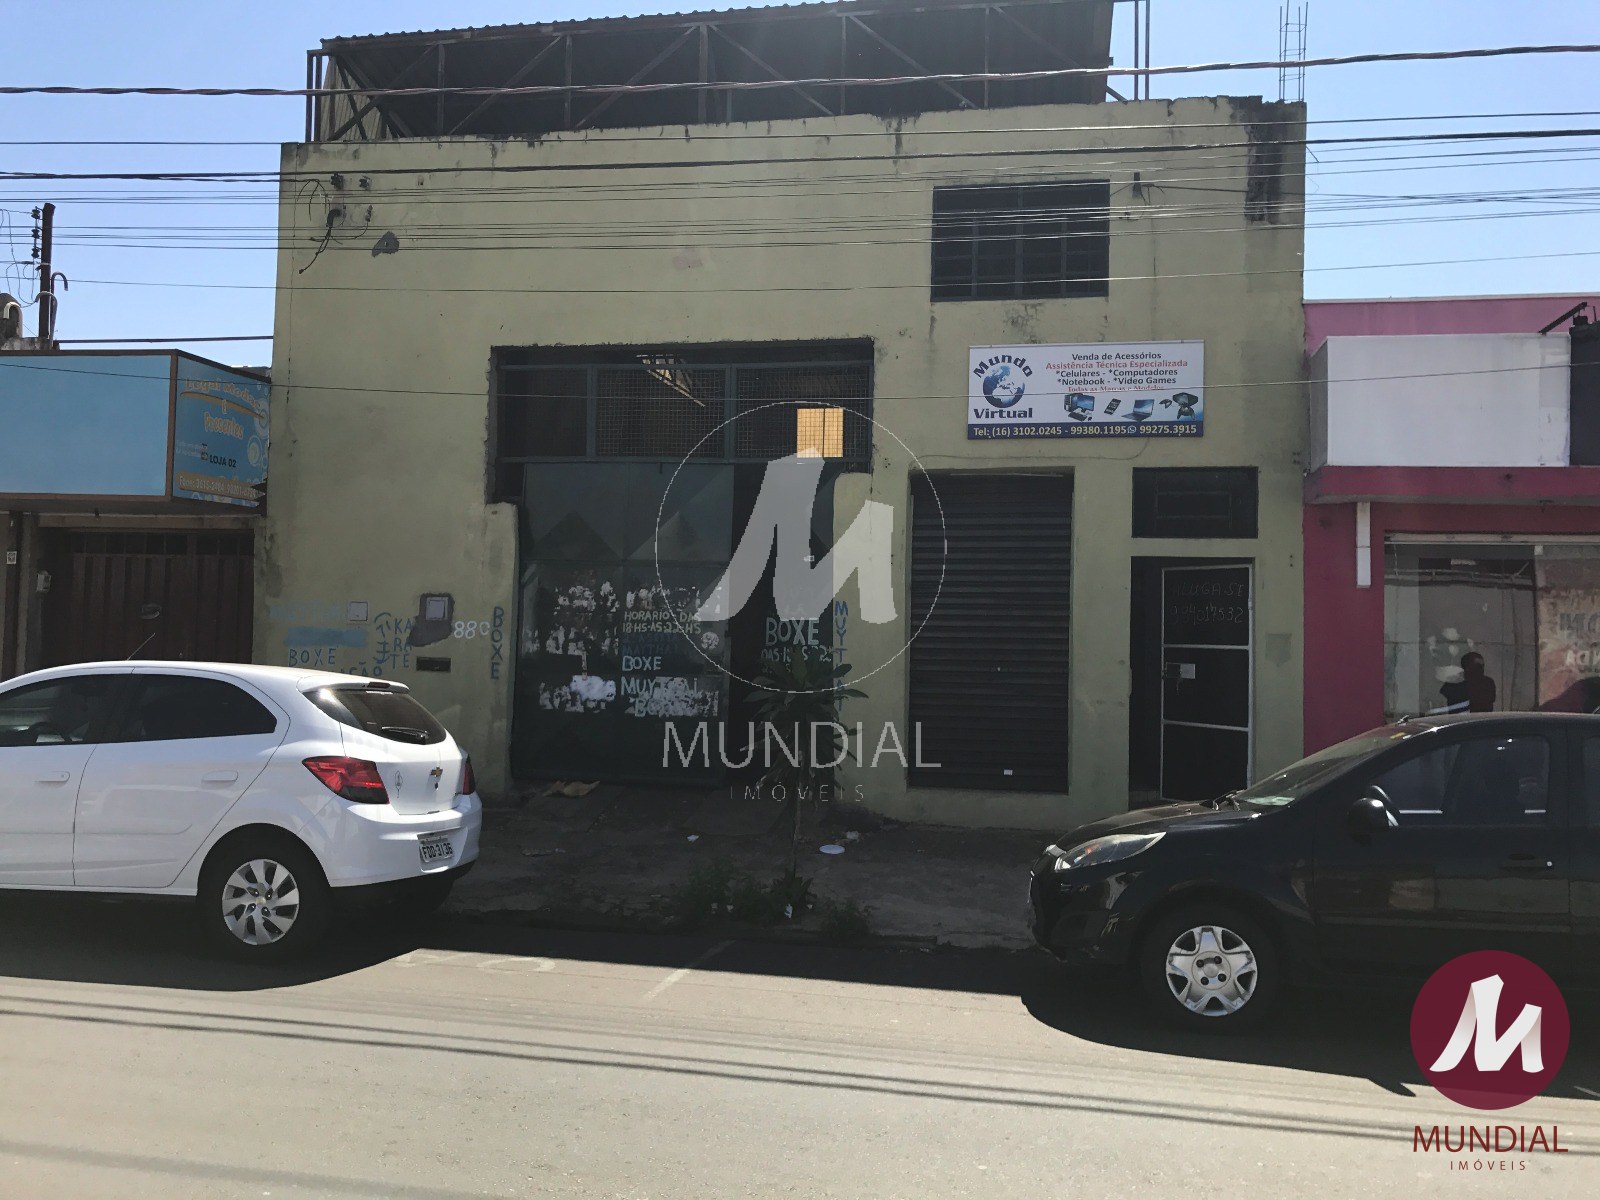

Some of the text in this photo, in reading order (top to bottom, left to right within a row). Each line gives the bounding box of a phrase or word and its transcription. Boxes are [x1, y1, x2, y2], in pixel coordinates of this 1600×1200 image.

[1072, 351, 1162, 361] Venda de Acessórios
[973, 354, 1033, 379] Mundo
[1045, 359, 1188, 370] Assistência Técnica Especializada
[1145, 376, 1177, 385] Games
[973, 407, 1033, 420] Virtual
[992, 426, 1011, 438] (16)
[1012, 425, 1062, 437] 3102.0245
[1070, 424, 1127, 436] 99380.1195
[1139, 423, 1197, 435] 99275.3915
[209, 455, 237, 468] LOJA 02
[765, 617, 820, 646] BOXE
[490, 606, 504, 680] BOXE
[289, 647, 337, 667] BOXE
[622, 655, 662, 671] BOXE
